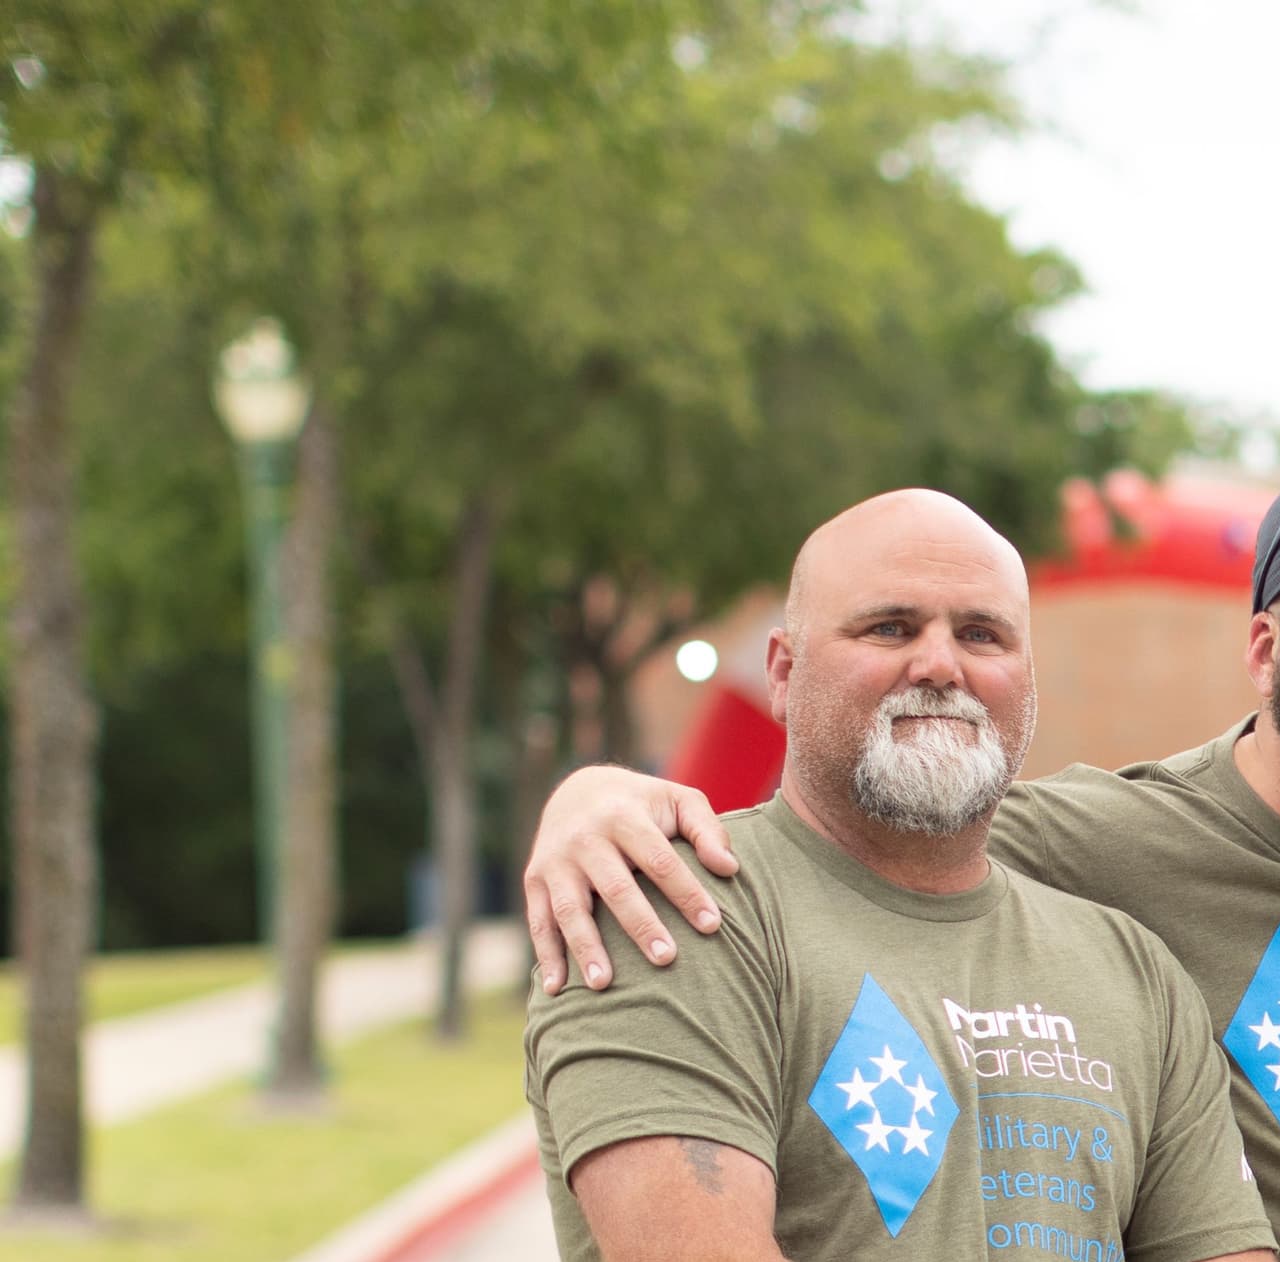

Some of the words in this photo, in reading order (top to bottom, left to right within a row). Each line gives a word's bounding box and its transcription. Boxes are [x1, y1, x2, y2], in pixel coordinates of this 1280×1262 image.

[976, 1110, 1081, 1161] ilitary
[1090, 1126, 1114, 1162] &
[980, 1168, 1097, 1213] eterans
